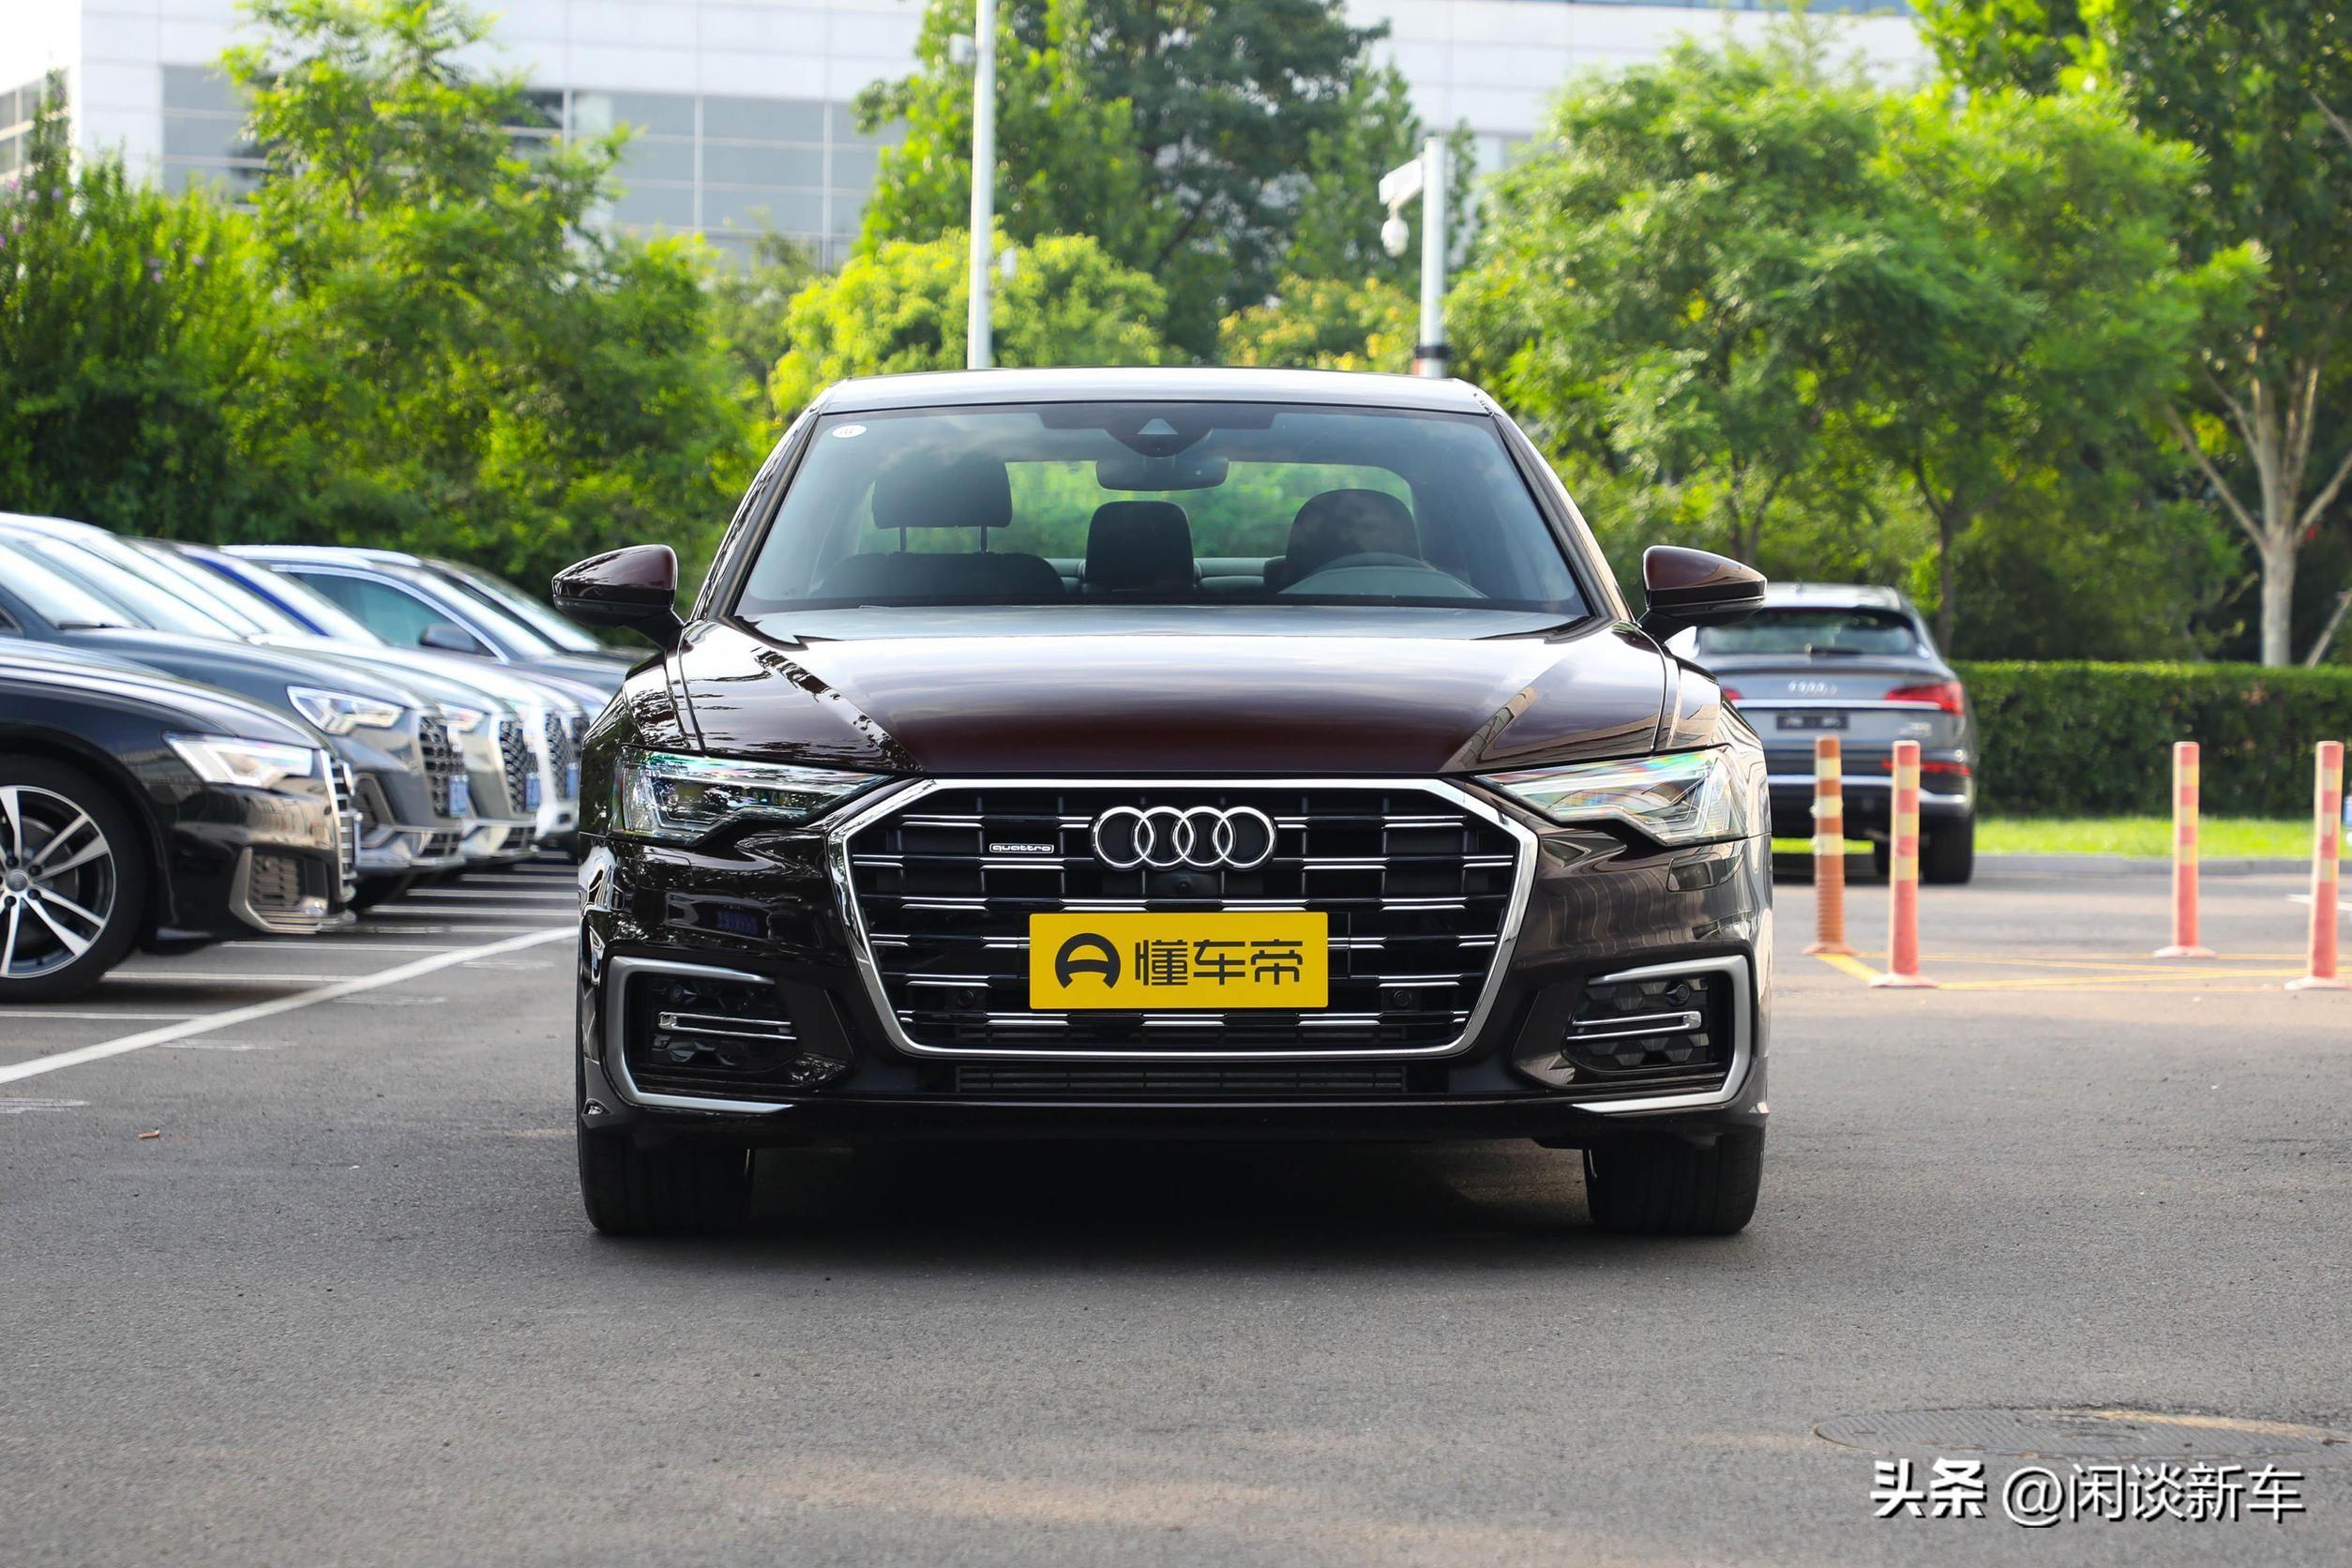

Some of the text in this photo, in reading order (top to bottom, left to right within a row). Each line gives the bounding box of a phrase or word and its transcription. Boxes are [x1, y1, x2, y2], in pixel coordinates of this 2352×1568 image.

[992, 844, 1051, 852] quattro
[1135, 939, 1304, 986] 懂车帝
